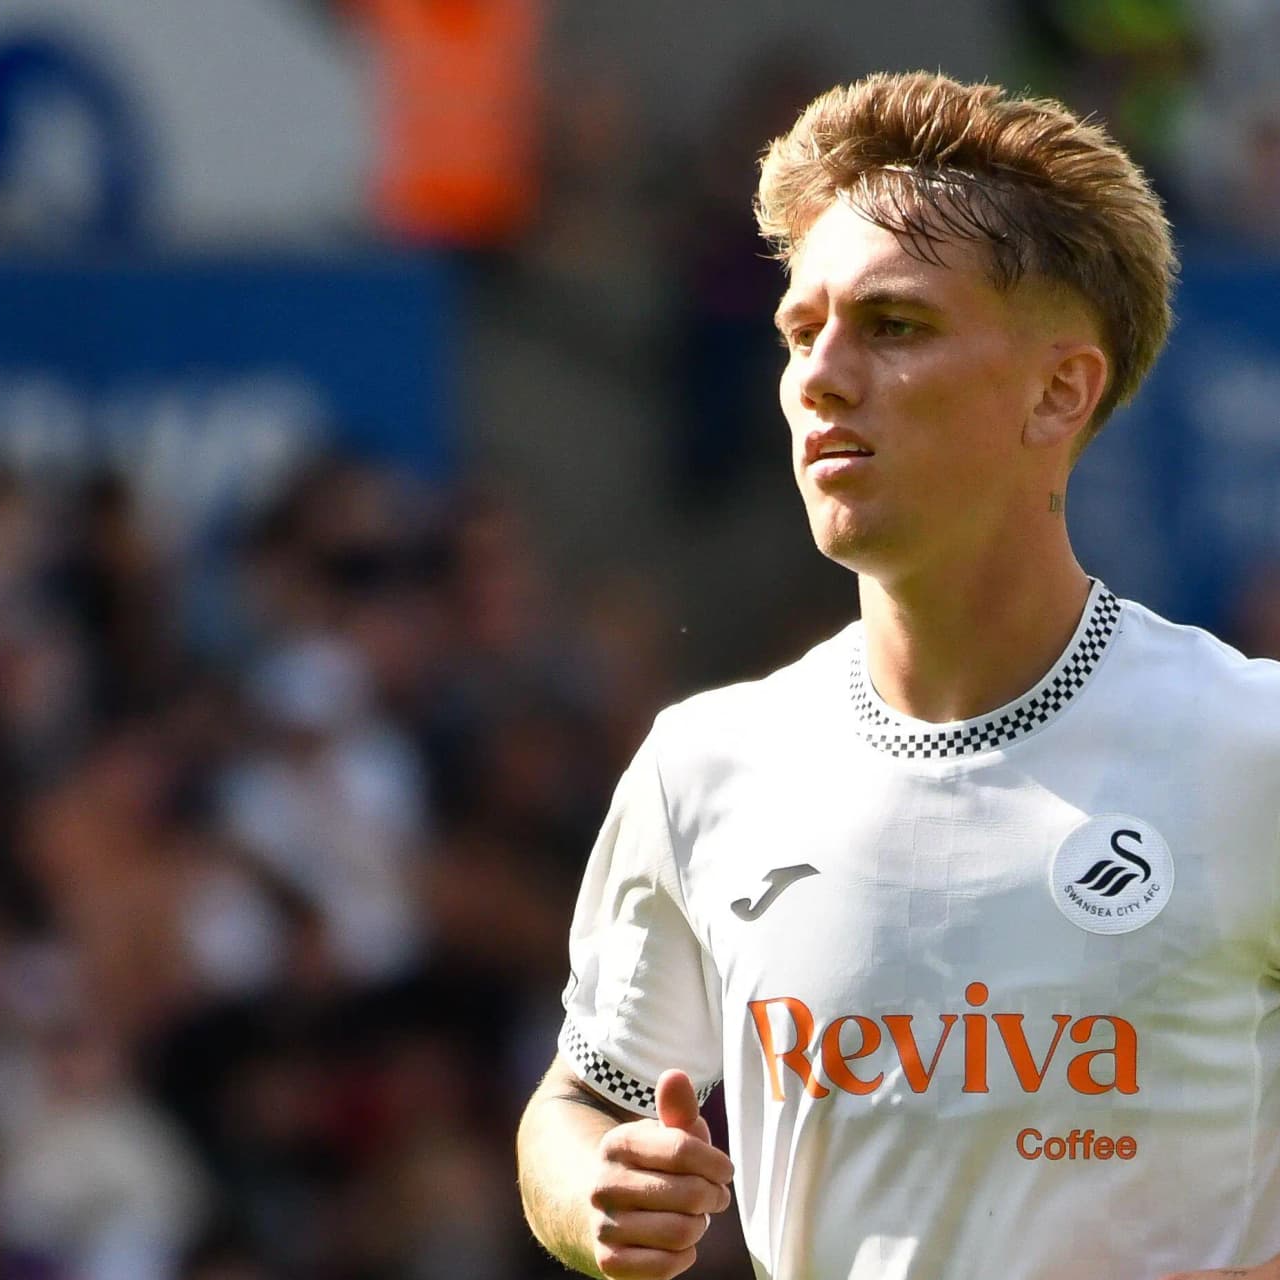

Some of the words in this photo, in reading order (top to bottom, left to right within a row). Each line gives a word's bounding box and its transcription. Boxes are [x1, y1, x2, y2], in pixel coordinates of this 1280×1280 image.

[1064, 885, 1112, 918] SWANSEA
[1116, 901, 1141, 917] CITY
[1143, 883, 1161, 904] AFC
[747, 982, 1140, 1101] Reviva
[1016, 1128, 1138, 1160] Coffee
